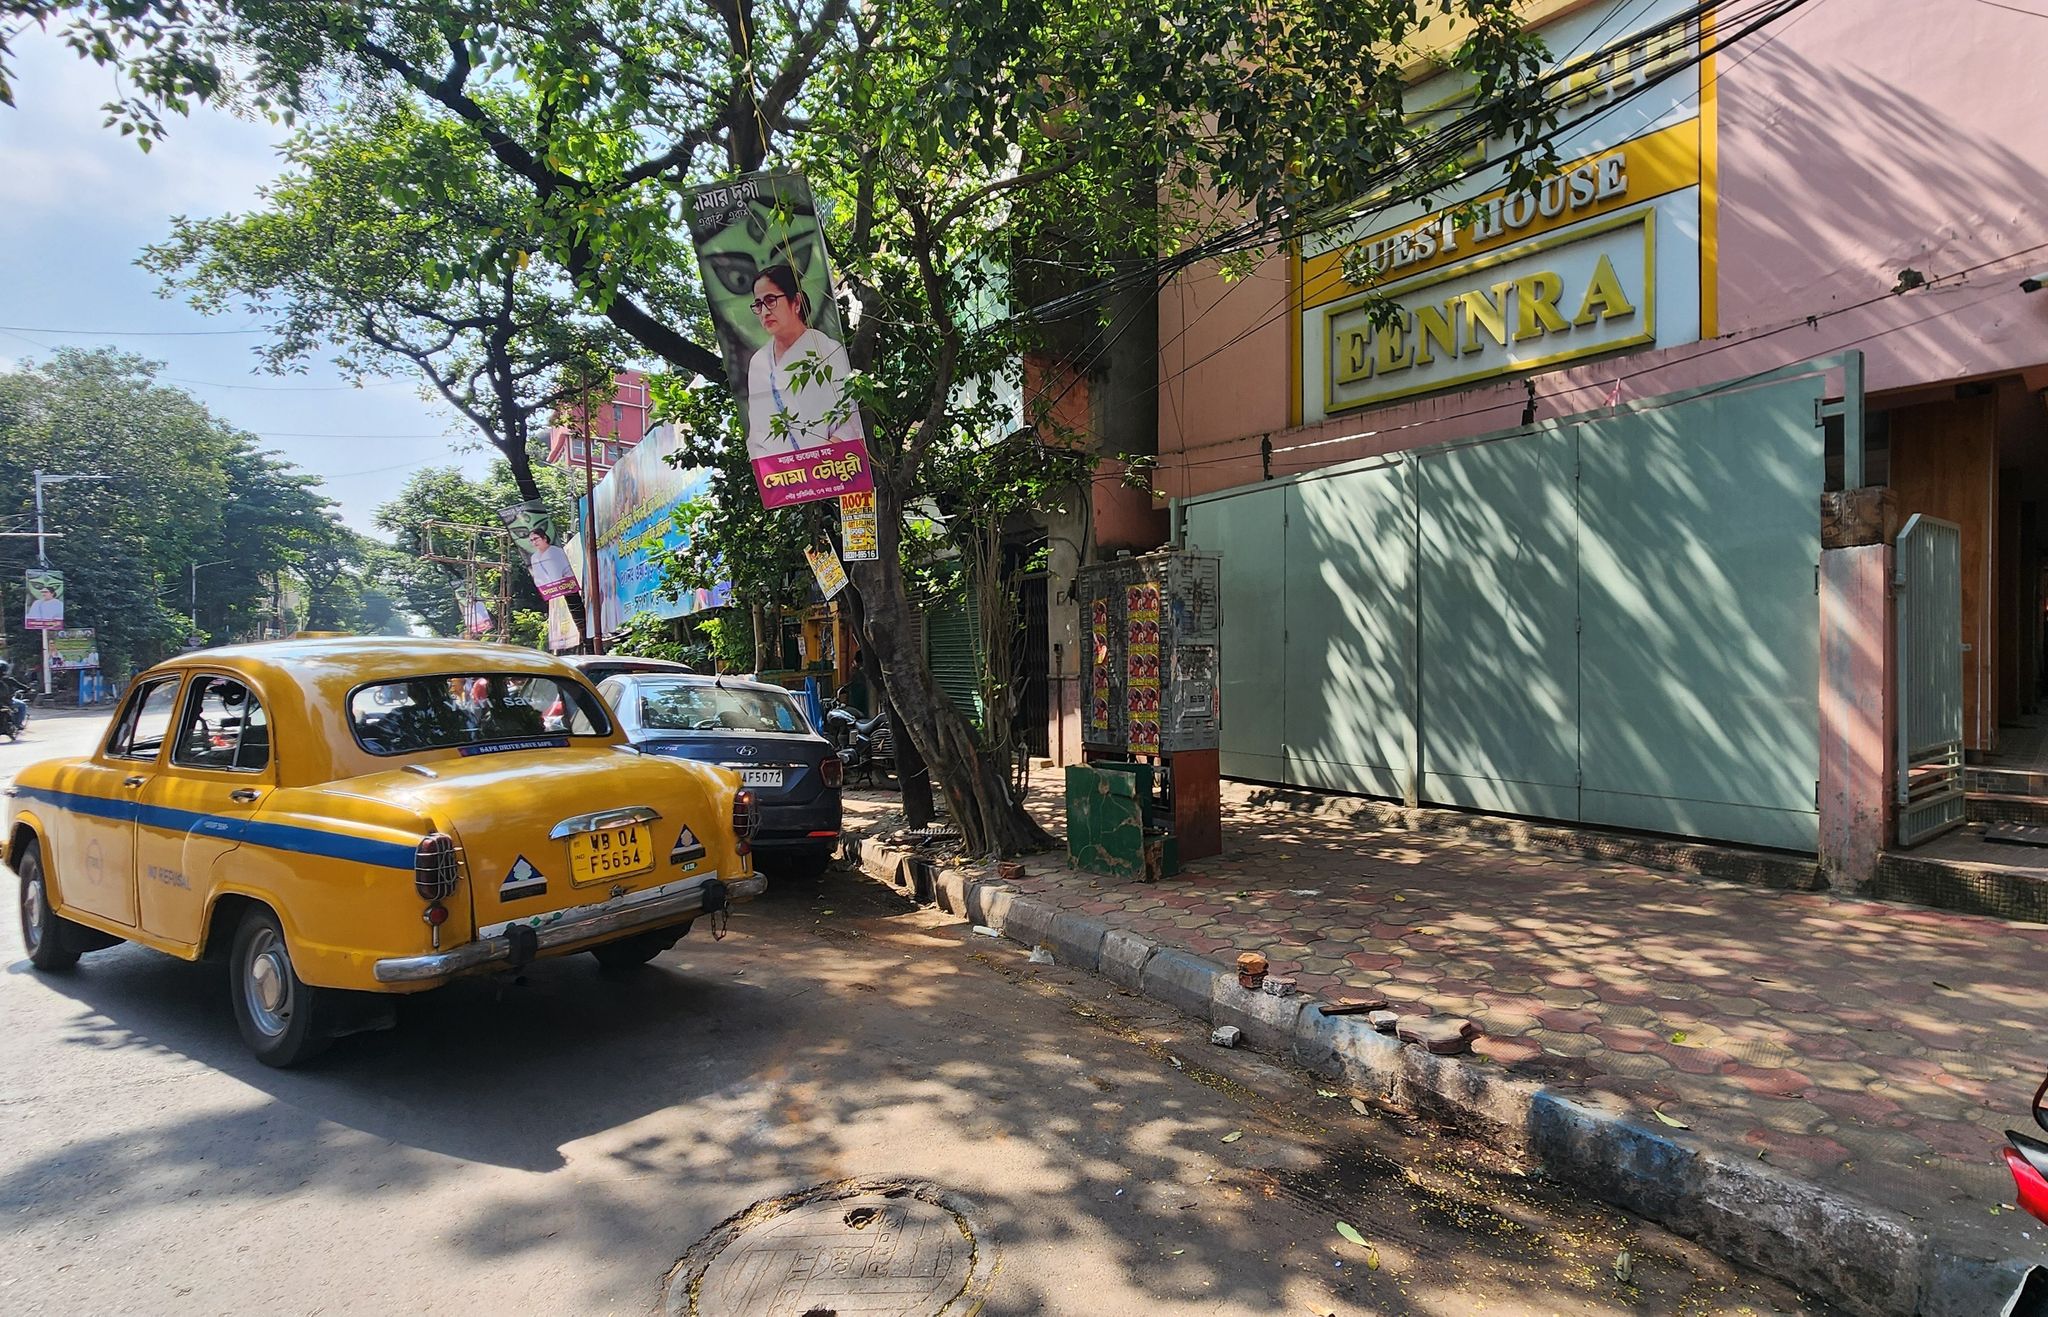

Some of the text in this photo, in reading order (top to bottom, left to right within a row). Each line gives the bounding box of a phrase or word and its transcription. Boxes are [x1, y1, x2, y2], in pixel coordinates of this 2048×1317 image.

[1472, 152, 1628, 243] HOUSE
[1335, 253, 1635, 385] EENNRA
[763, 452, 863, 489] সোমা চৌধুরী
[841, 492, 873, 510] ROOT
[842, 506, 873, 515] COMPUTER
[742, 771, 781, 783] AF5072
[590, 827, 637, 851] WB 04
[590, 847, 640, 874] F5654
